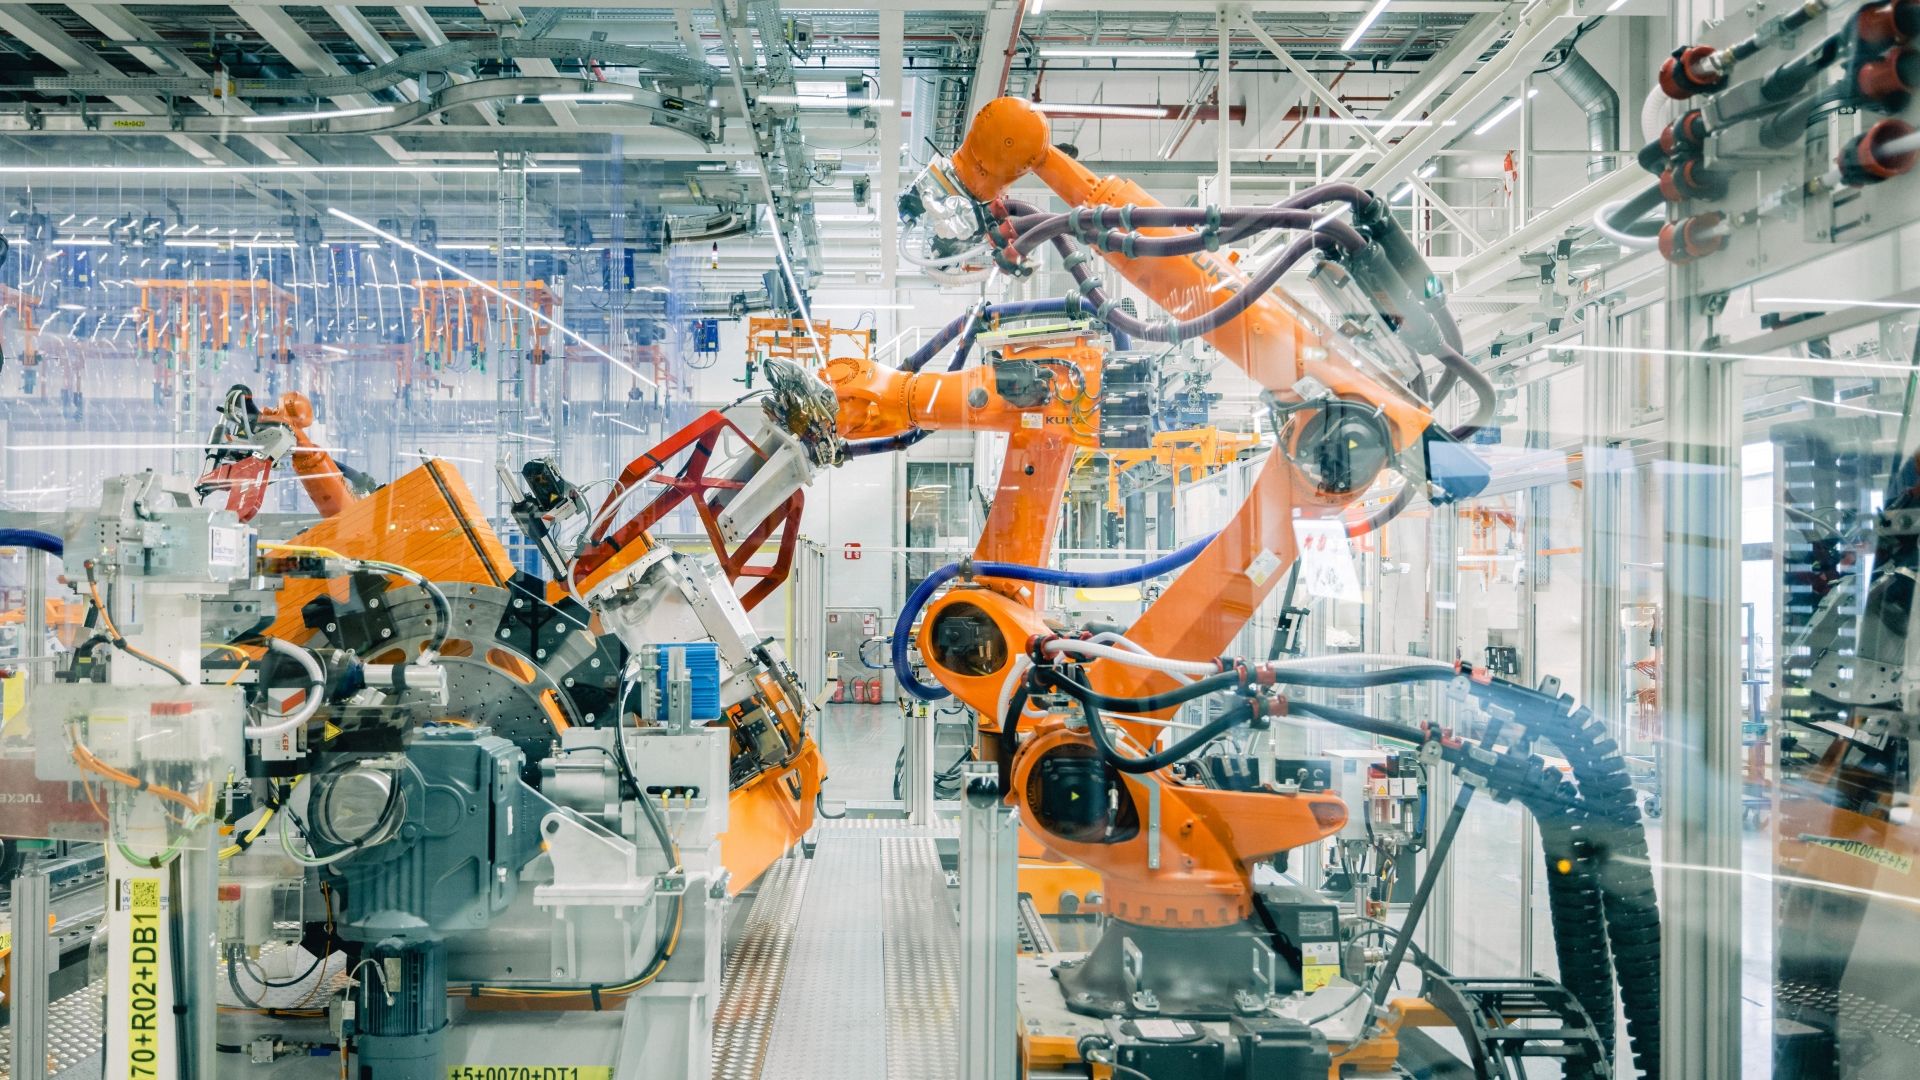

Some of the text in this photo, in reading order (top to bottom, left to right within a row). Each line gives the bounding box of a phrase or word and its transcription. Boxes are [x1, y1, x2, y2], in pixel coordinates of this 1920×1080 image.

[1045, 416, 1086, 425] KUKA
[131, 914, 158, 1079] 70+R02+DB1
[451, 1067, 579, 1080] +5+0070+DT1
